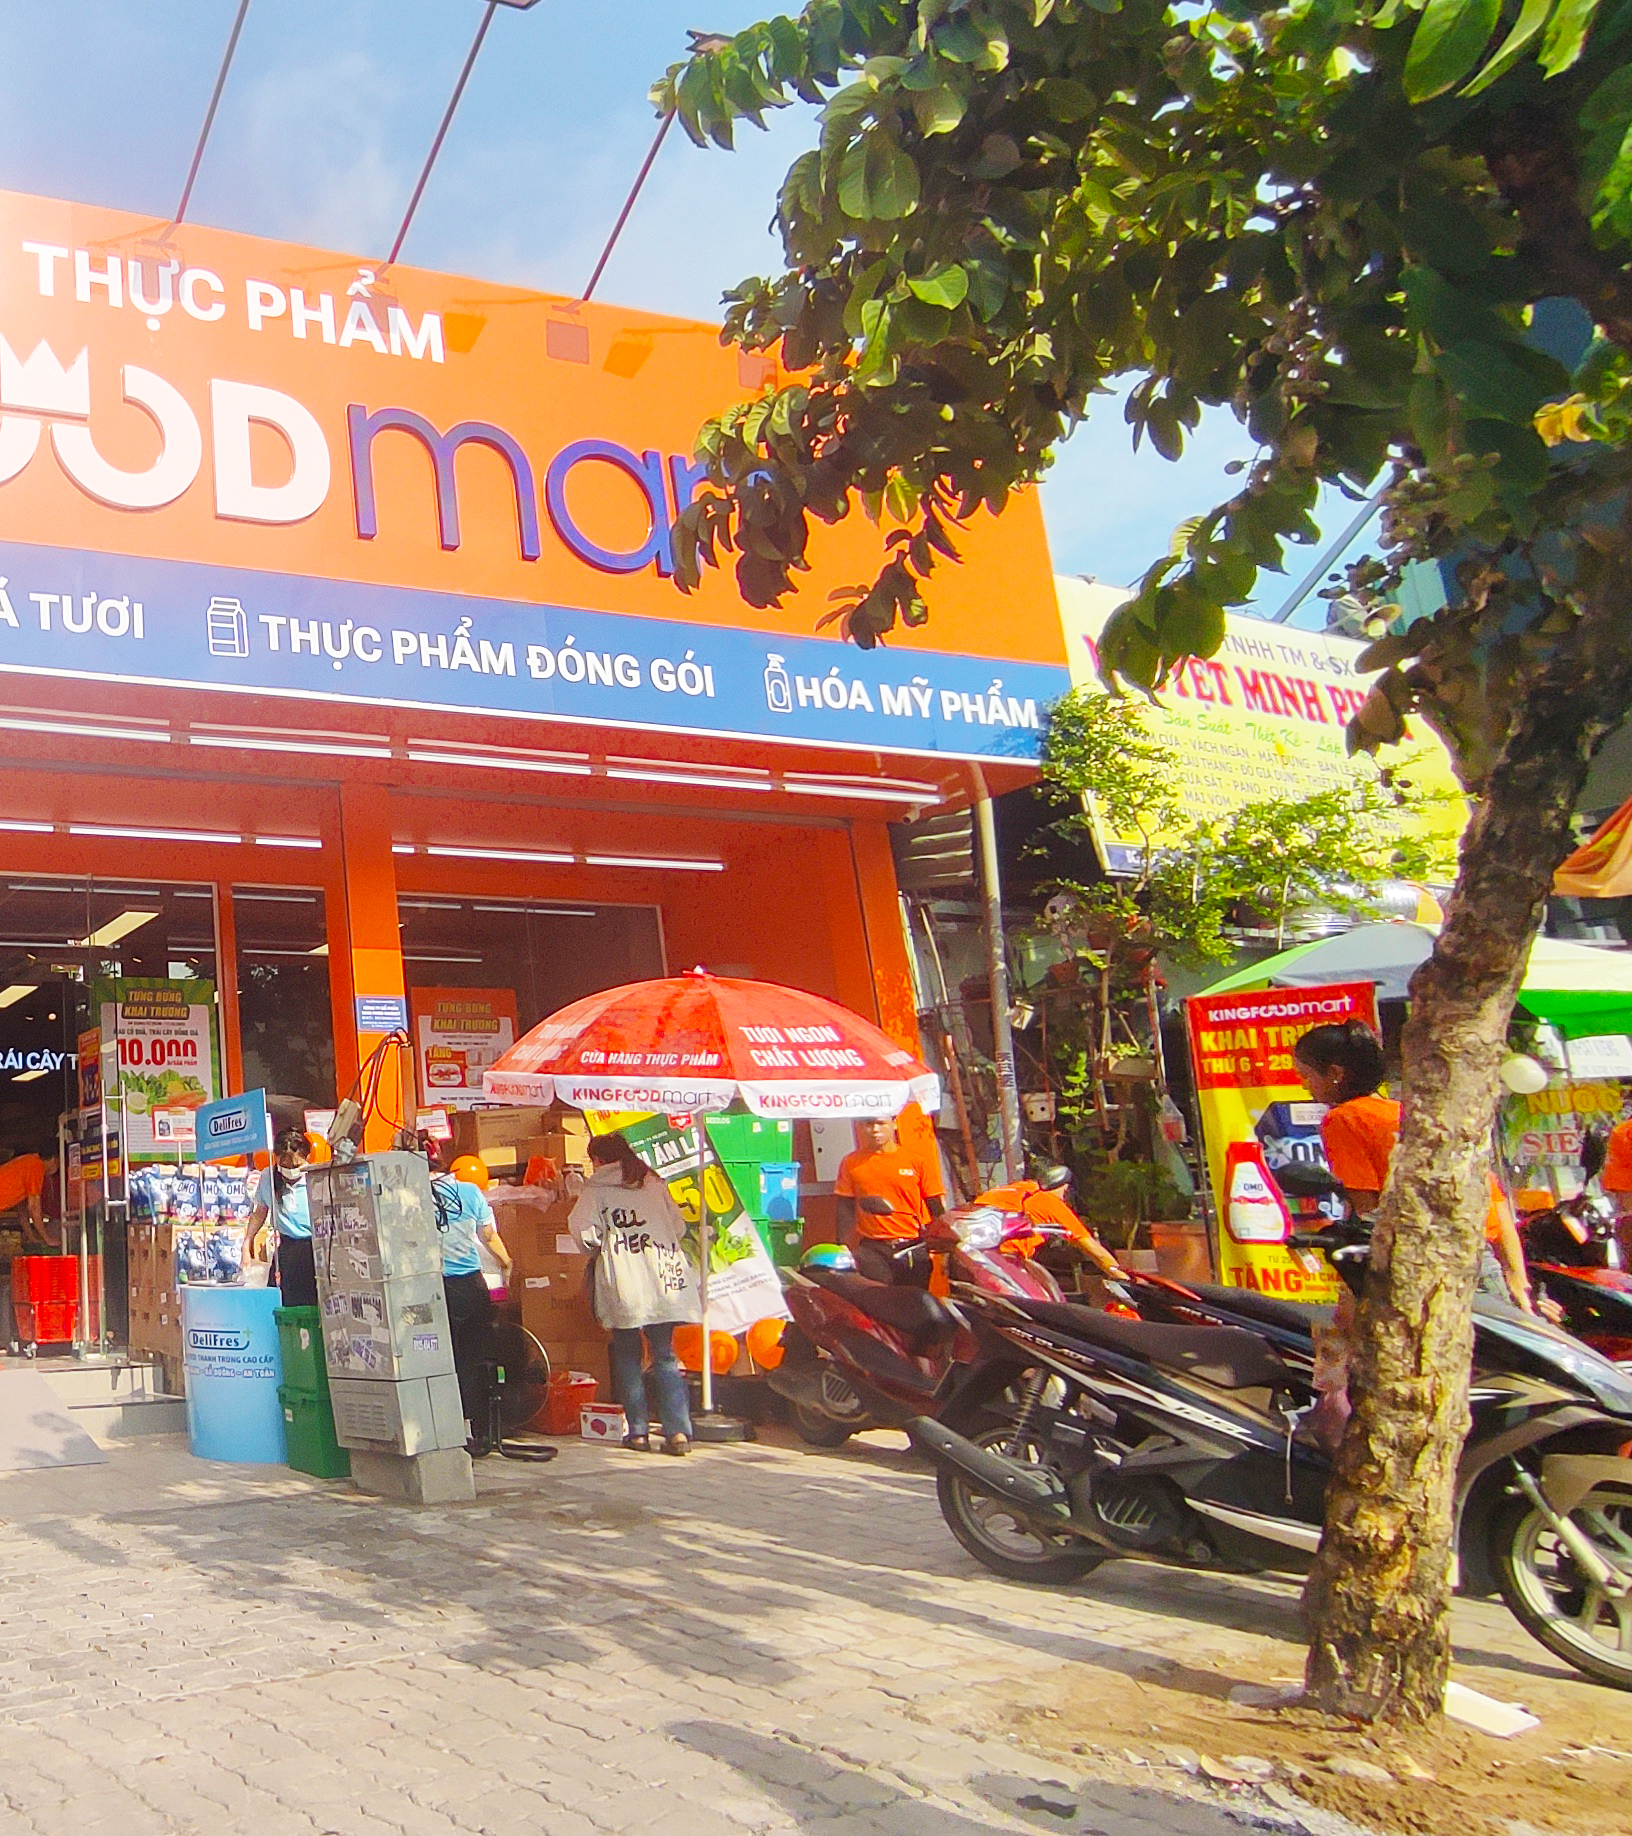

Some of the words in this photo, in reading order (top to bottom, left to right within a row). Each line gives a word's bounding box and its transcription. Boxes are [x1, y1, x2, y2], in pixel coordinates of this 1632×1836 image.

[21, 239, 226, 333] THỰC
[245, 268, 446, 364] PHẨM
[30, 590, 145, 640] TƯƠI
[259, 611, 384, 671] THỰC
[392, 615, 517, 679] PHẨM
[528, 634, 641, 691] ĐÓNG
[650, 650, 715, 700] GÓI
[1277, 644, 1307, 667] TM
[1310, 652, 1325, 671] &
[1326, 656, 1355, 677] SX
[797, 666, 874, 716] HÓA
[881, 676, 936, 721] MỸ
[941, 677, 1041, 730] PHẨM
[1234, 666, 1328, 725] MINH
[739, 1026, 784, 1043] TƯƠI
[783, 1026, 840, 1043] NGON
[1200, 1027, 1258, 1052] KHAI
[26, 1049, 65, 1070] CÂY
[608, 1050, 641, 1065] HÀNG
[750, 1045, 799, 1067] CHẤT
[799, 1049, 865, 1070] LƯỢNG
[1201, 1054, 1236, 1074] THỨ
[1239, 1056, 1251, 1072] 6
[1243, 1183, 1264, 1192] OMO
[614, 1232, 652, 1254] HER
[664, 1276, 688, 1293] HER
[193, 1333, 240, 1346] DeliFres
